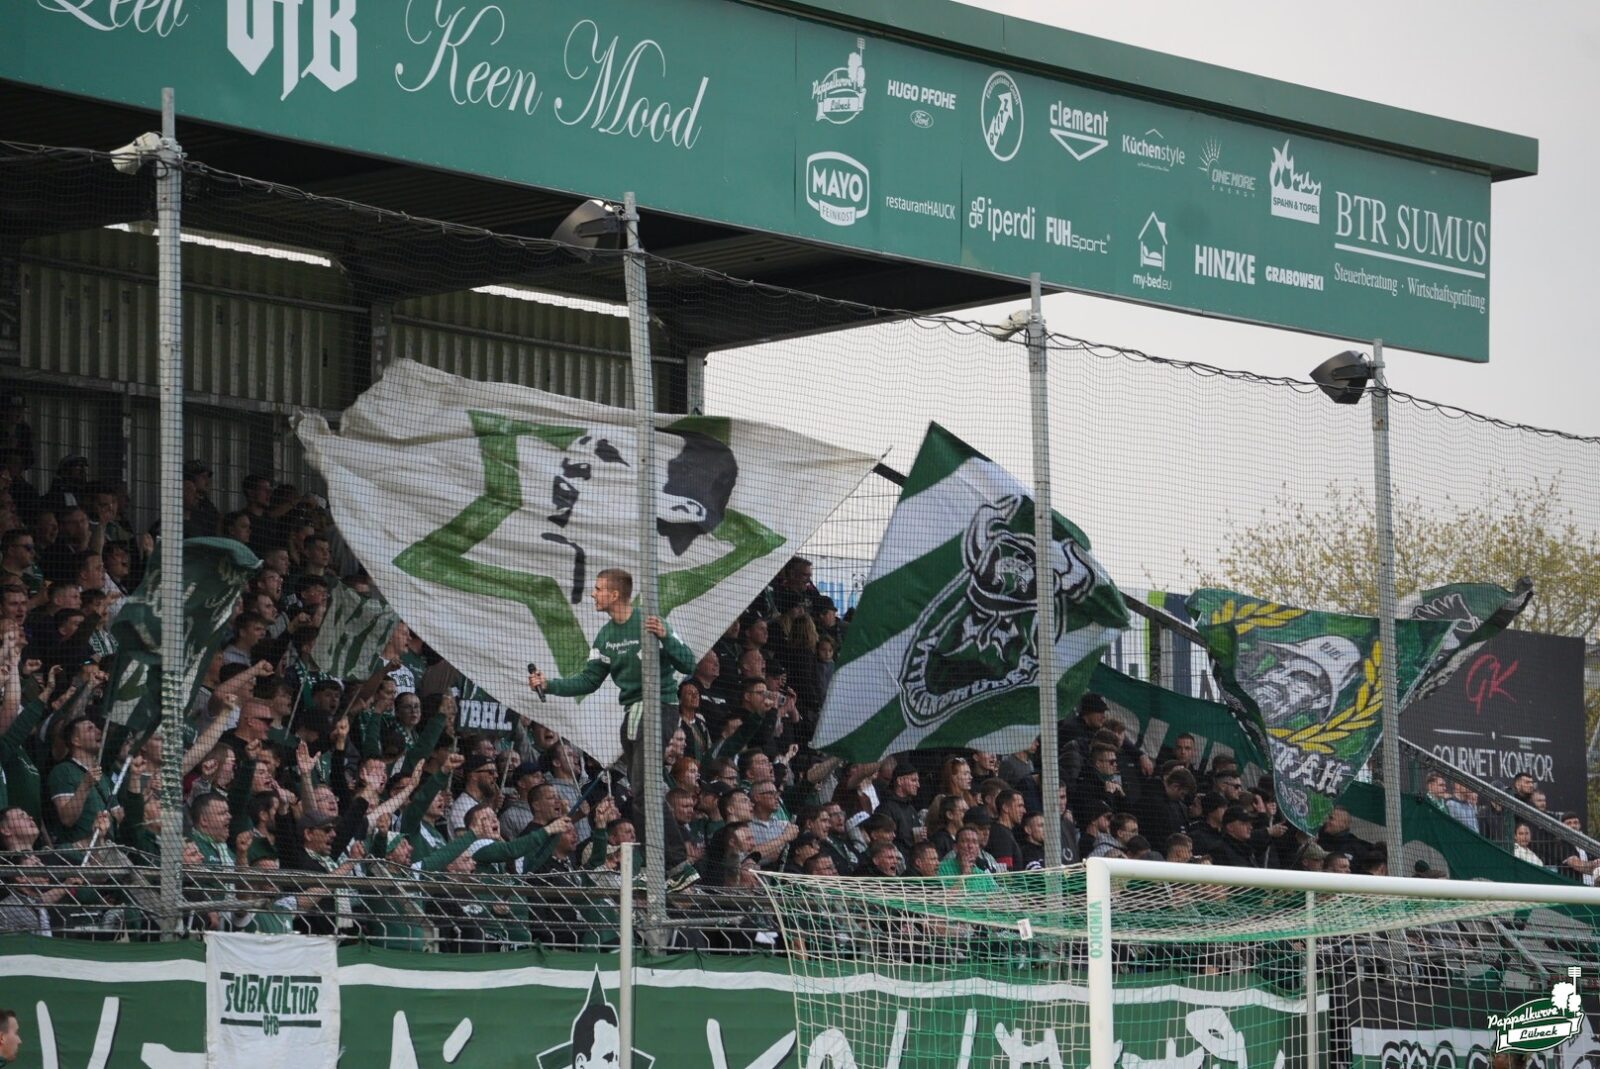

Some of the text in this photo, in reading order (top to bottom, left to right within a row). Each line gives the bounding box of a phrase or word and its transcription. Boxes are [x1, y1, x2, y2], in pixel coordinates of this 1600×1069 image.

[395, 0, 709, 149] Keen Mood
[887, 79, 957, 110] HUGO PFOHE
[1049, 100, 1109, 136] clement
[1122, 134, 1186, 167] Küchenstyle
[812, 165, 864, 202] MAYO
[821, 205, 856, 223] FEINKOST
[886, 195, 956, 220] restaurantHAUCK
[987, 198, 1036, 242] iperdi
[1272, 196, 1294, 209] SPAHN
[1299, 202, 1319, 214] TOPEL
[1335, 191, 1487, 266] BTR SUMUS
[1133, 273, 1172, 290] my-bed.eu
[1195, 244, 1256, 285] HINZKE
[1265, 265, 1324, 291] GRABOWSKI
[1334, 262, 1486, 314] Steuerberatung Wirtschaftsprüfung
[459, 699, 513, 731] VBHL
[224, 974, 319, 1015] SUBKULTUR
